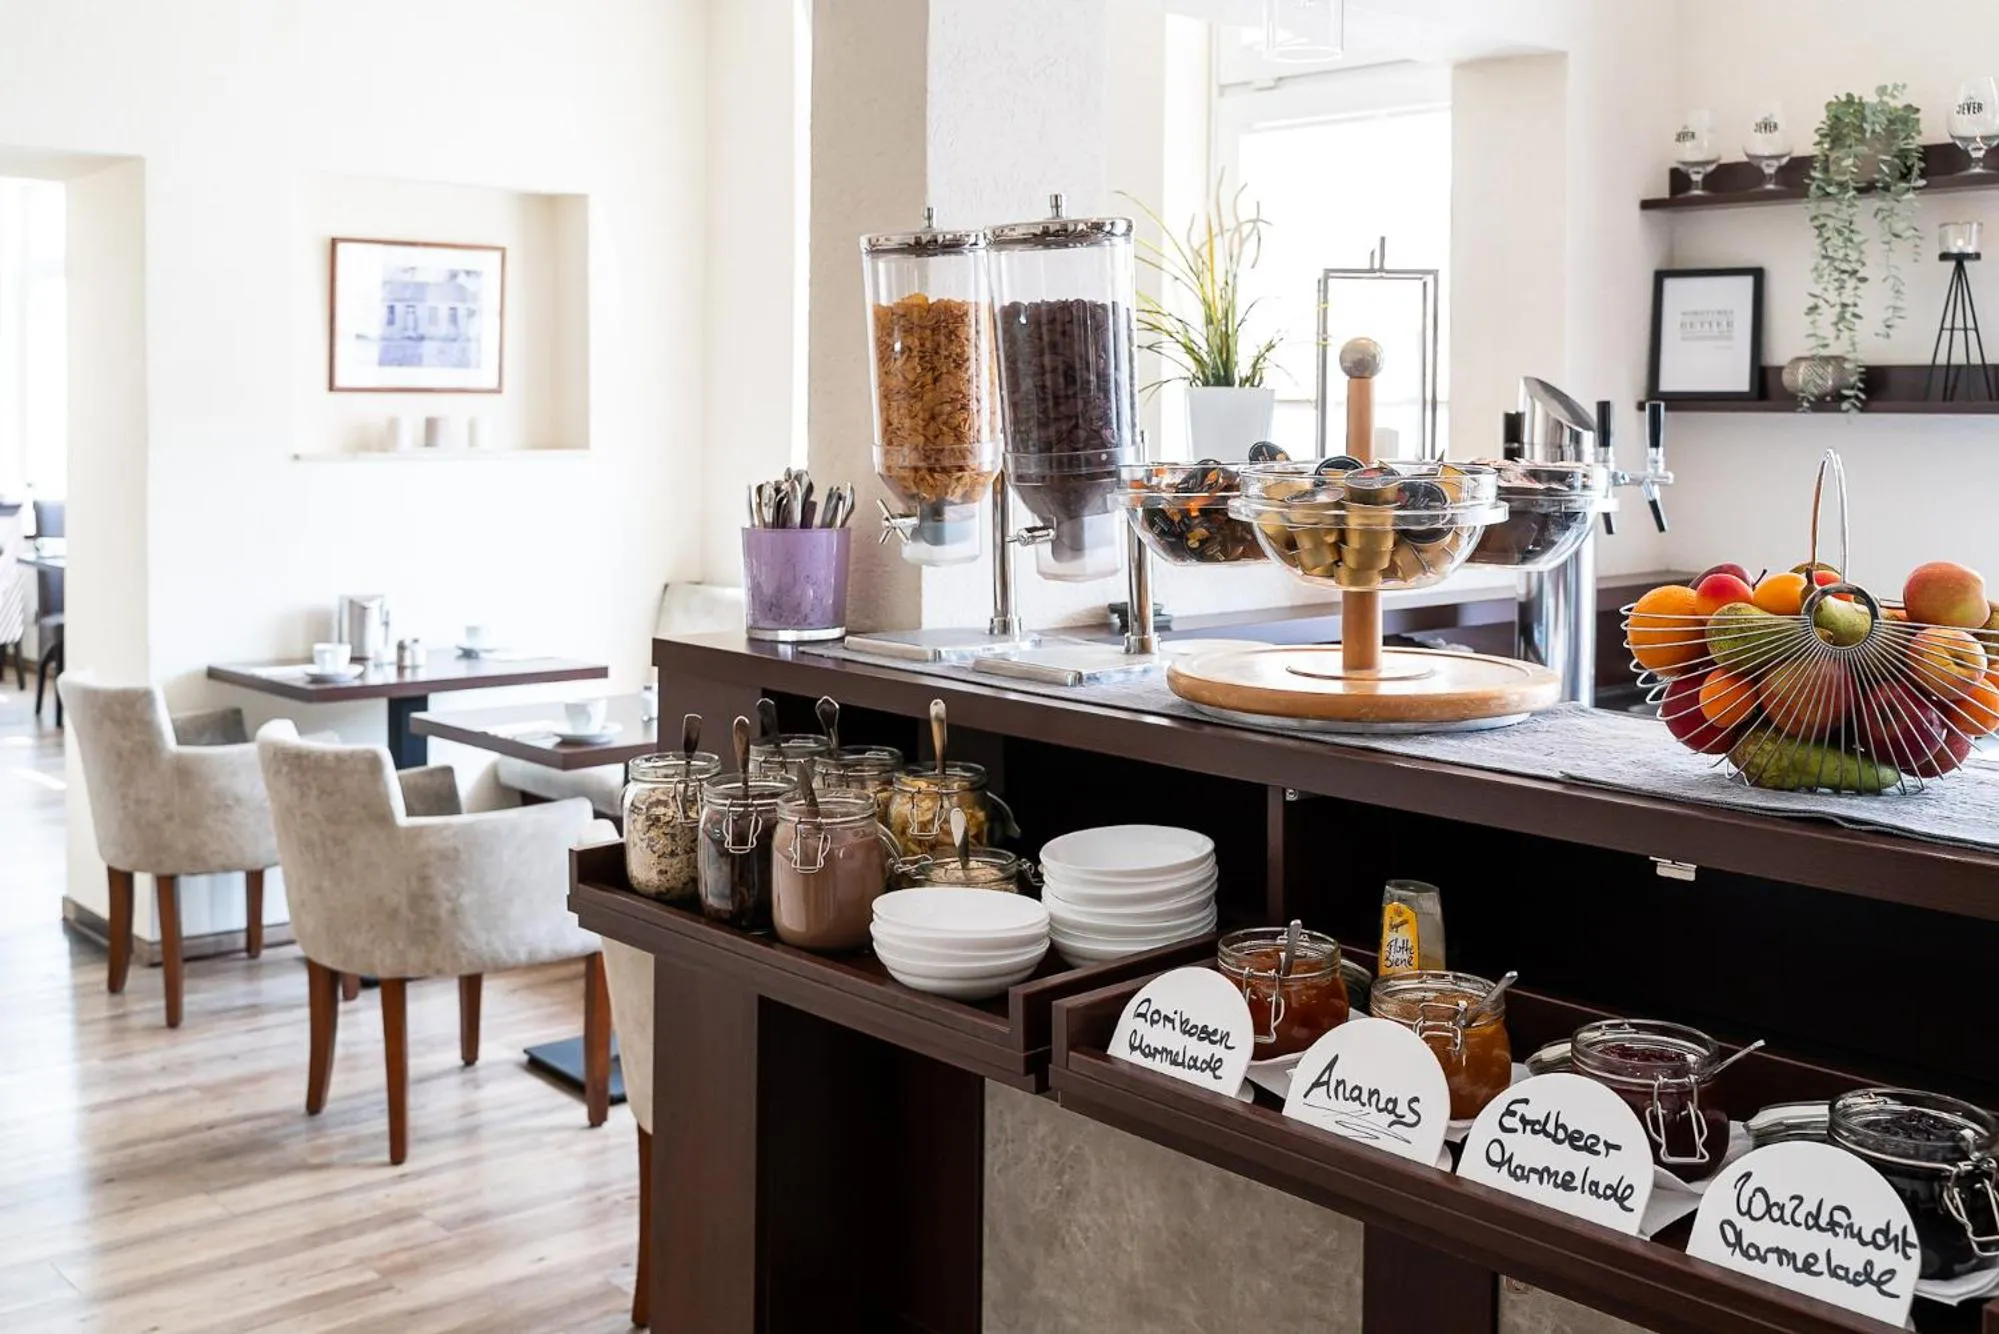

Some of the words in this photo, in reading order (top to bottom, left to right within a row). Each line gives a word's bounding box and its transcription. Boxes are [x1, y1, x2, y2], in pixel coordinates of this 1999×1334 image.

[1753, 121, 1778, 134] JEVER
[1956, 101, 1984, 115] JEVER
[1133, 997, 1236, 1050] Aprikosen
[1128, 1028, 1223, 1080] Marmelade
[1303, 1053, 1422, 1129] Ananas
[1498, 1098, 1622, 1158] Erdbeer
[1485, 1138, 1635, 1213] Marmelade
[1719, 1219, 1901, 1299] Marmelade
